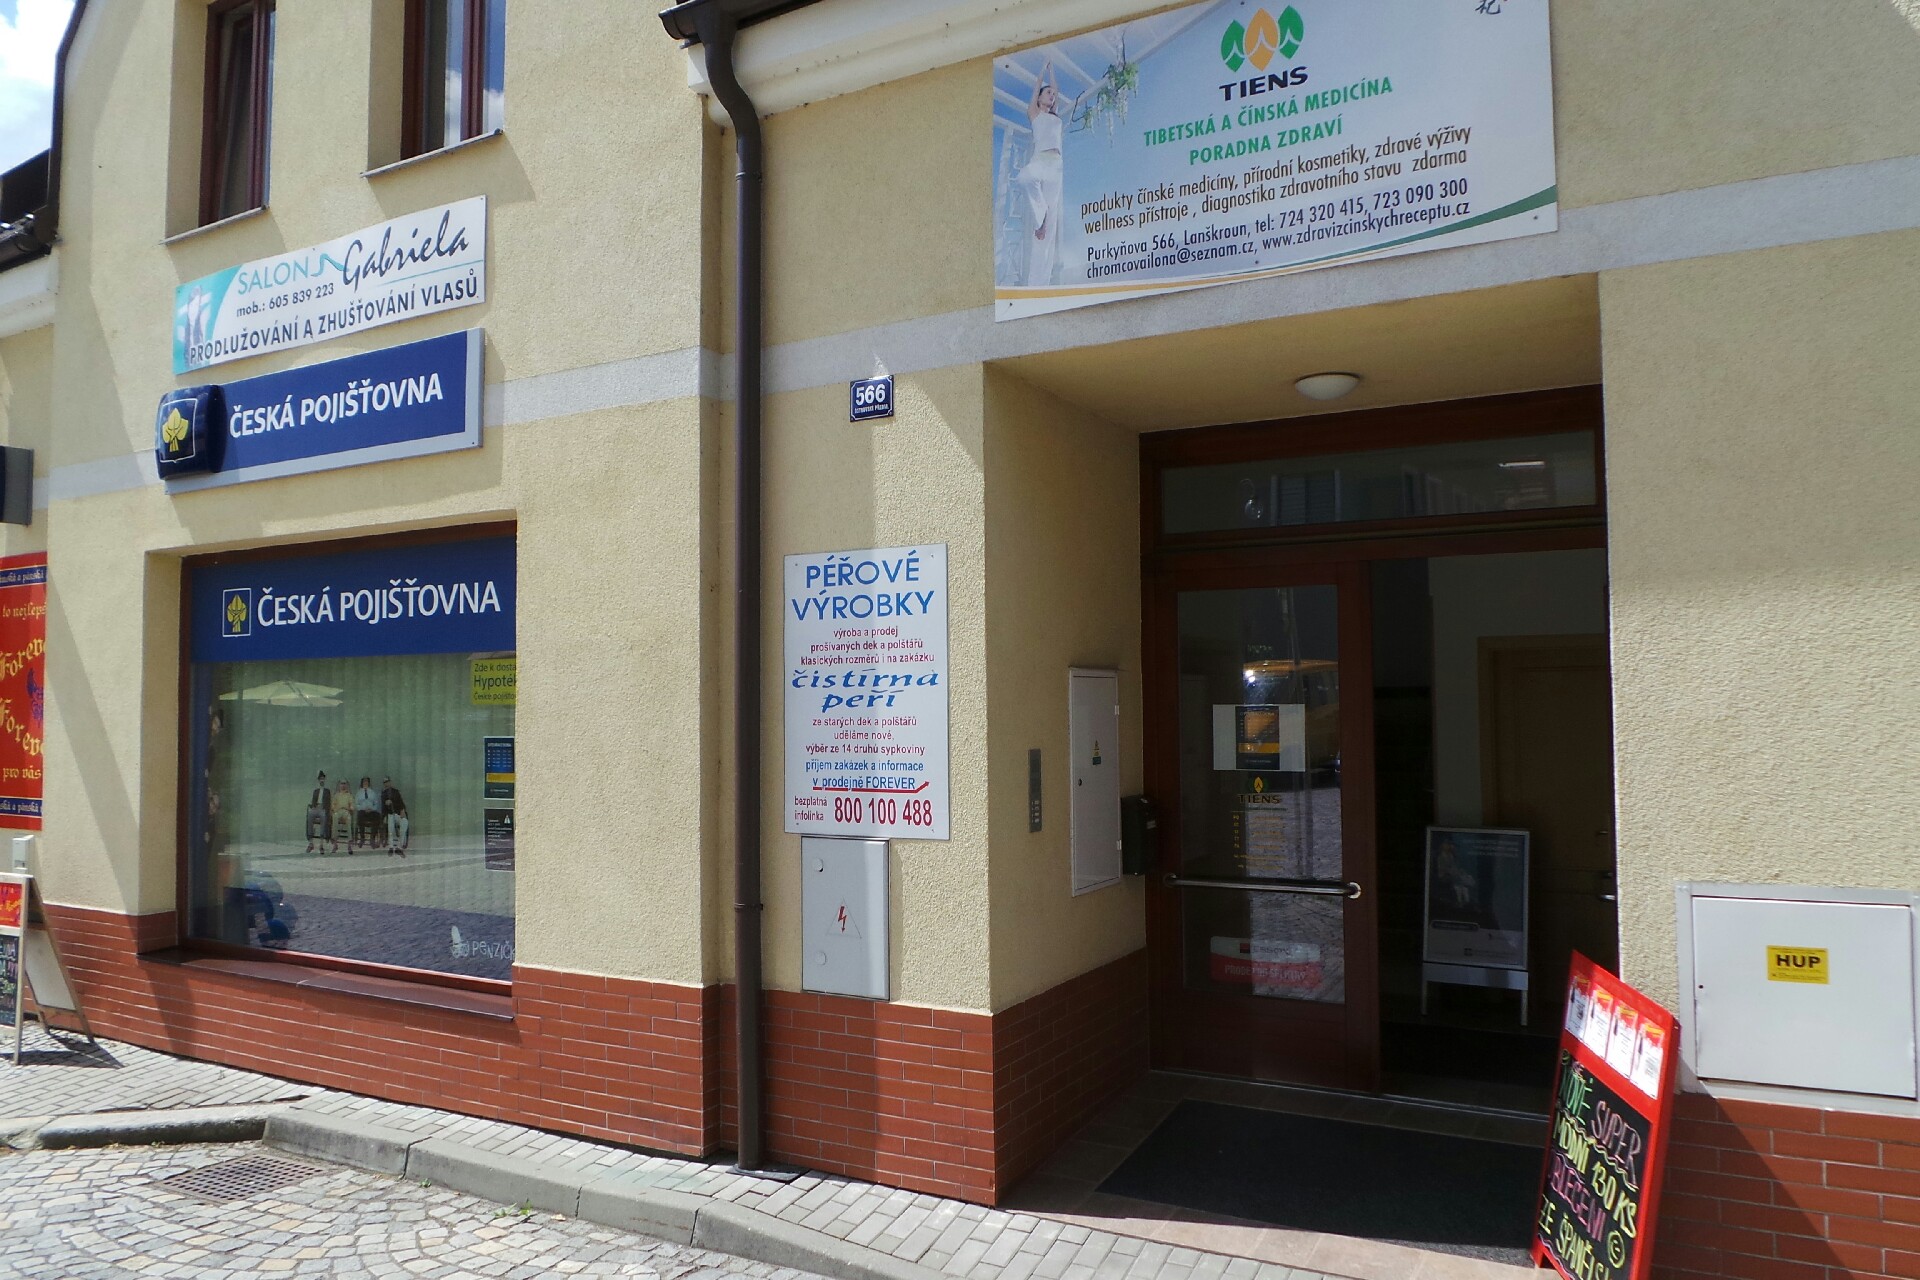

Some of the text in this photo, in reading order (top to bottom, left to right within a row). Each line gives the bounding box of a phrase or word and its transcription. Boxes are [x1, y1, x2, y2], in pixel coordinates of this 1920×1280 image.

[1219, 66, 1309, 102] TIENS
[1143, 76, 1393, 147] TIBETSKÁ A ČÍNSKÁ MEDICÍNA
[1190, 114, 1343, 165] PORADNA ZDRAVÍ
[1081, 126, 1472, 219] produkty čínské medicíny, přírodní kosmetiky, zdravé výživy
[1084, 212, 1135, 235] wellness
[1139, 202, 1189, 229] přístroje
[1202, 186, 1276, 214] diagnostika
[1280, 167, 1359, 198] zdravotního
[1364, 162, 1402, 181] stavu
[1412, 150, 1467, 172] zdarma
[1088, 178, 1468, 262] Purkyňova 566, Lanškroun, tel: 724 320 415, 723 090 300
[238, 209, 470, 295] SALON Gabriela
[1087, 202, 1471, 279] chromcovailona@seznam.cz, www.zdravizcinskychreceptu.cz
[236, 282, 335, 317] mob.: 605 839 223
[190, 268, 478, 364] PRODLUŽOVÁNÍ A ZHUŠŤOVÁNÍ VLASŮ
[229, 372, 444, 438] ČESKÁ POJIŠŤOVNA
[855, 383, 886, 406] 566
[806, 549, 920, 588] PÉŘOVÉ
[257, 577, 501, 627] ČESKÁ POJIŠŤOVNA
[791, 589, 935, 621] VÝROBKY
[810, 638, 923, 654] prošívaných dek a polštářů
[833, 625, 899, 640] výroba a prodej
[801, 654, 843, 667] klasických
[845, 653, 880, 664] rozměrů
[887, 655, 897, 663] na
[899, 652, 935, 663] zakázku
[792, 668, 939, 688] čistírna
[822, 690, 904, 713] peří
[813, 716, 917, 728] ze starých dek a polštářů
[834, 730, 869, 740] uděláme
[806, 743, 925, 756] výběr ze 14 druhů sypkoviny
[805, 759, 924, 773] příjem zakázek a informace
[812, 776, 916, 791] v prodejně FOREVER
[1238, 793, 1283, 805] TIENS
[794, 796, 828, 808] bezplatná
[794, 810, 824, 821] infolinka
[834, 796, 933, 827] 800 100 488
[1775, 954, 1821, 968] HUP
[1591, 1101, 1641, 1187] SUPER
[1592, 1161, 1618, 1211] 130
[1612, 1191, 1637, 1239] KS
